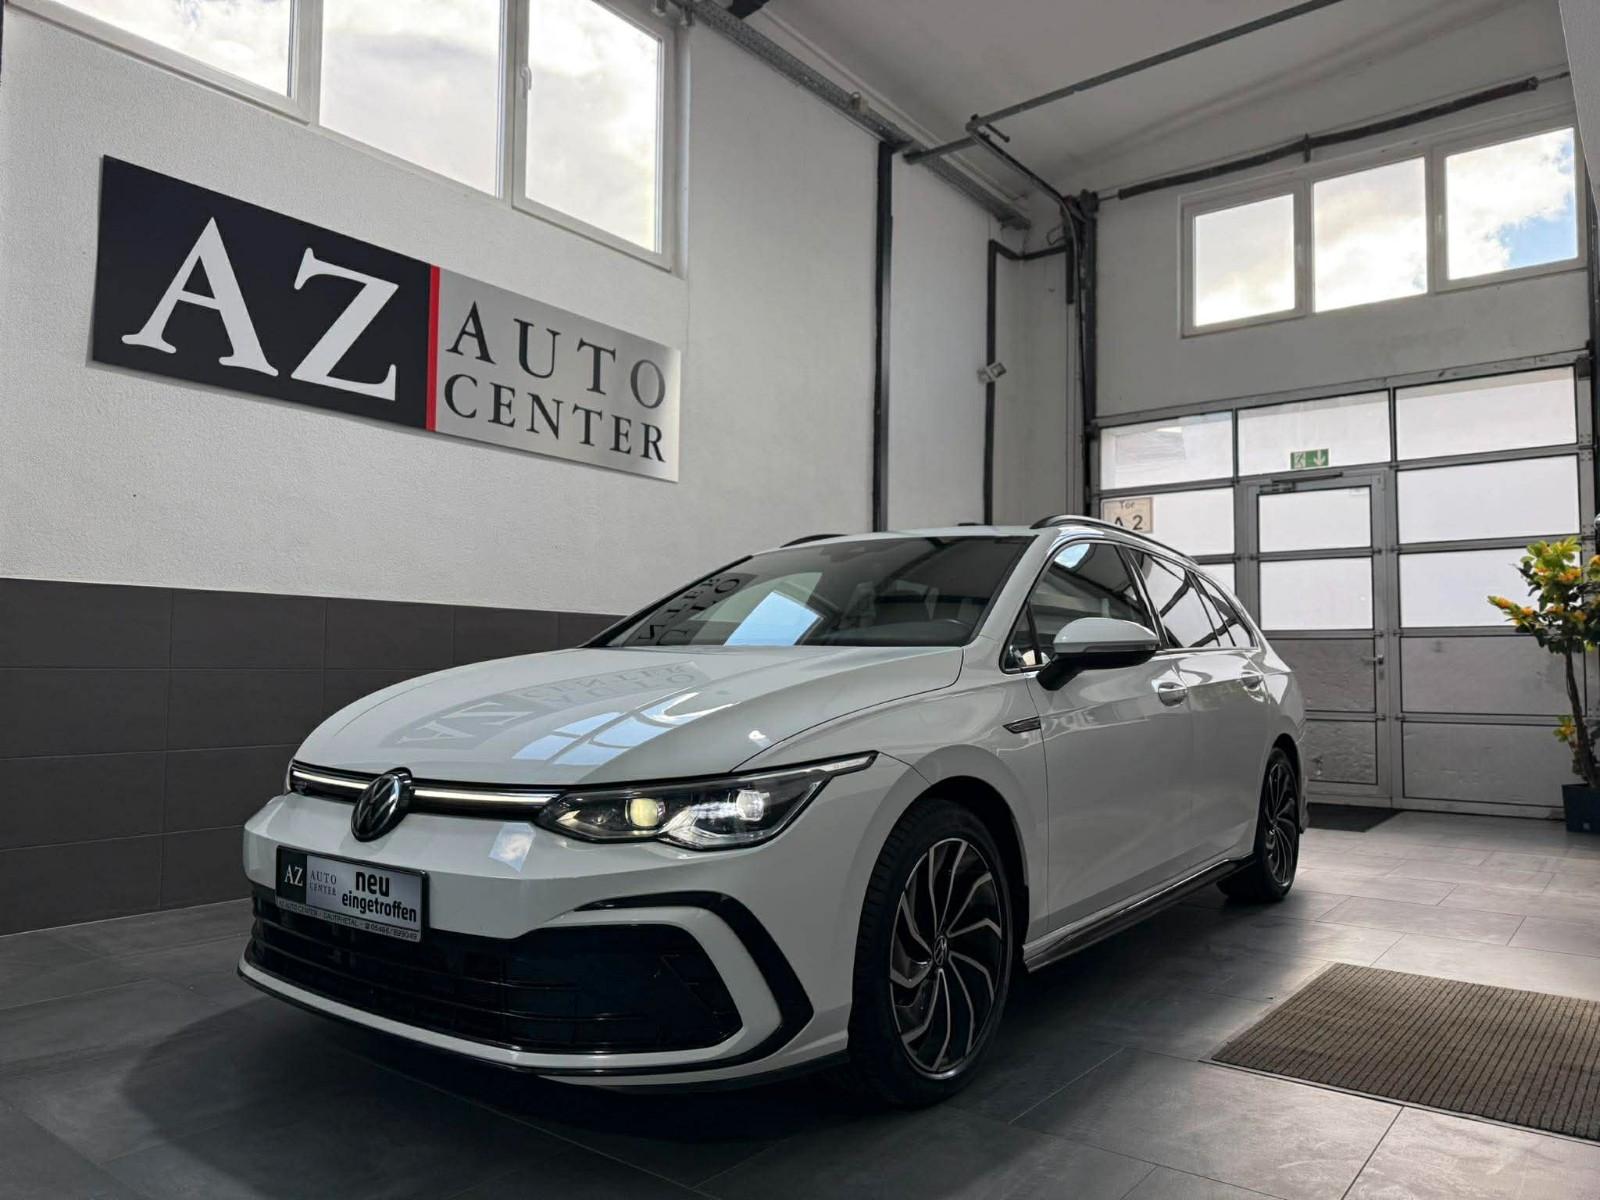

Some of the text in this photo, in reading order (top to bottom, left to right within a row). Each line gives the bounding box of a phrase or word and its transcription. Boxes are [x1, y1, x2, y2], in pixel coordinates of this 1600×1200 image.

[121, 216, 399, 401] AZ
[445, 301, 666, 408] AUTO
[444, 374, 666, 463] CENTER
[1132, 514, 1143, 530] 2
[284, 863, 303, 887] AZ
[310, 870, 337, 885] AUTO
[355, 871, 389, 897] neu
[309, 881, 337, 896] CENTER
[342, 890, 417, 923] eingetroffen
